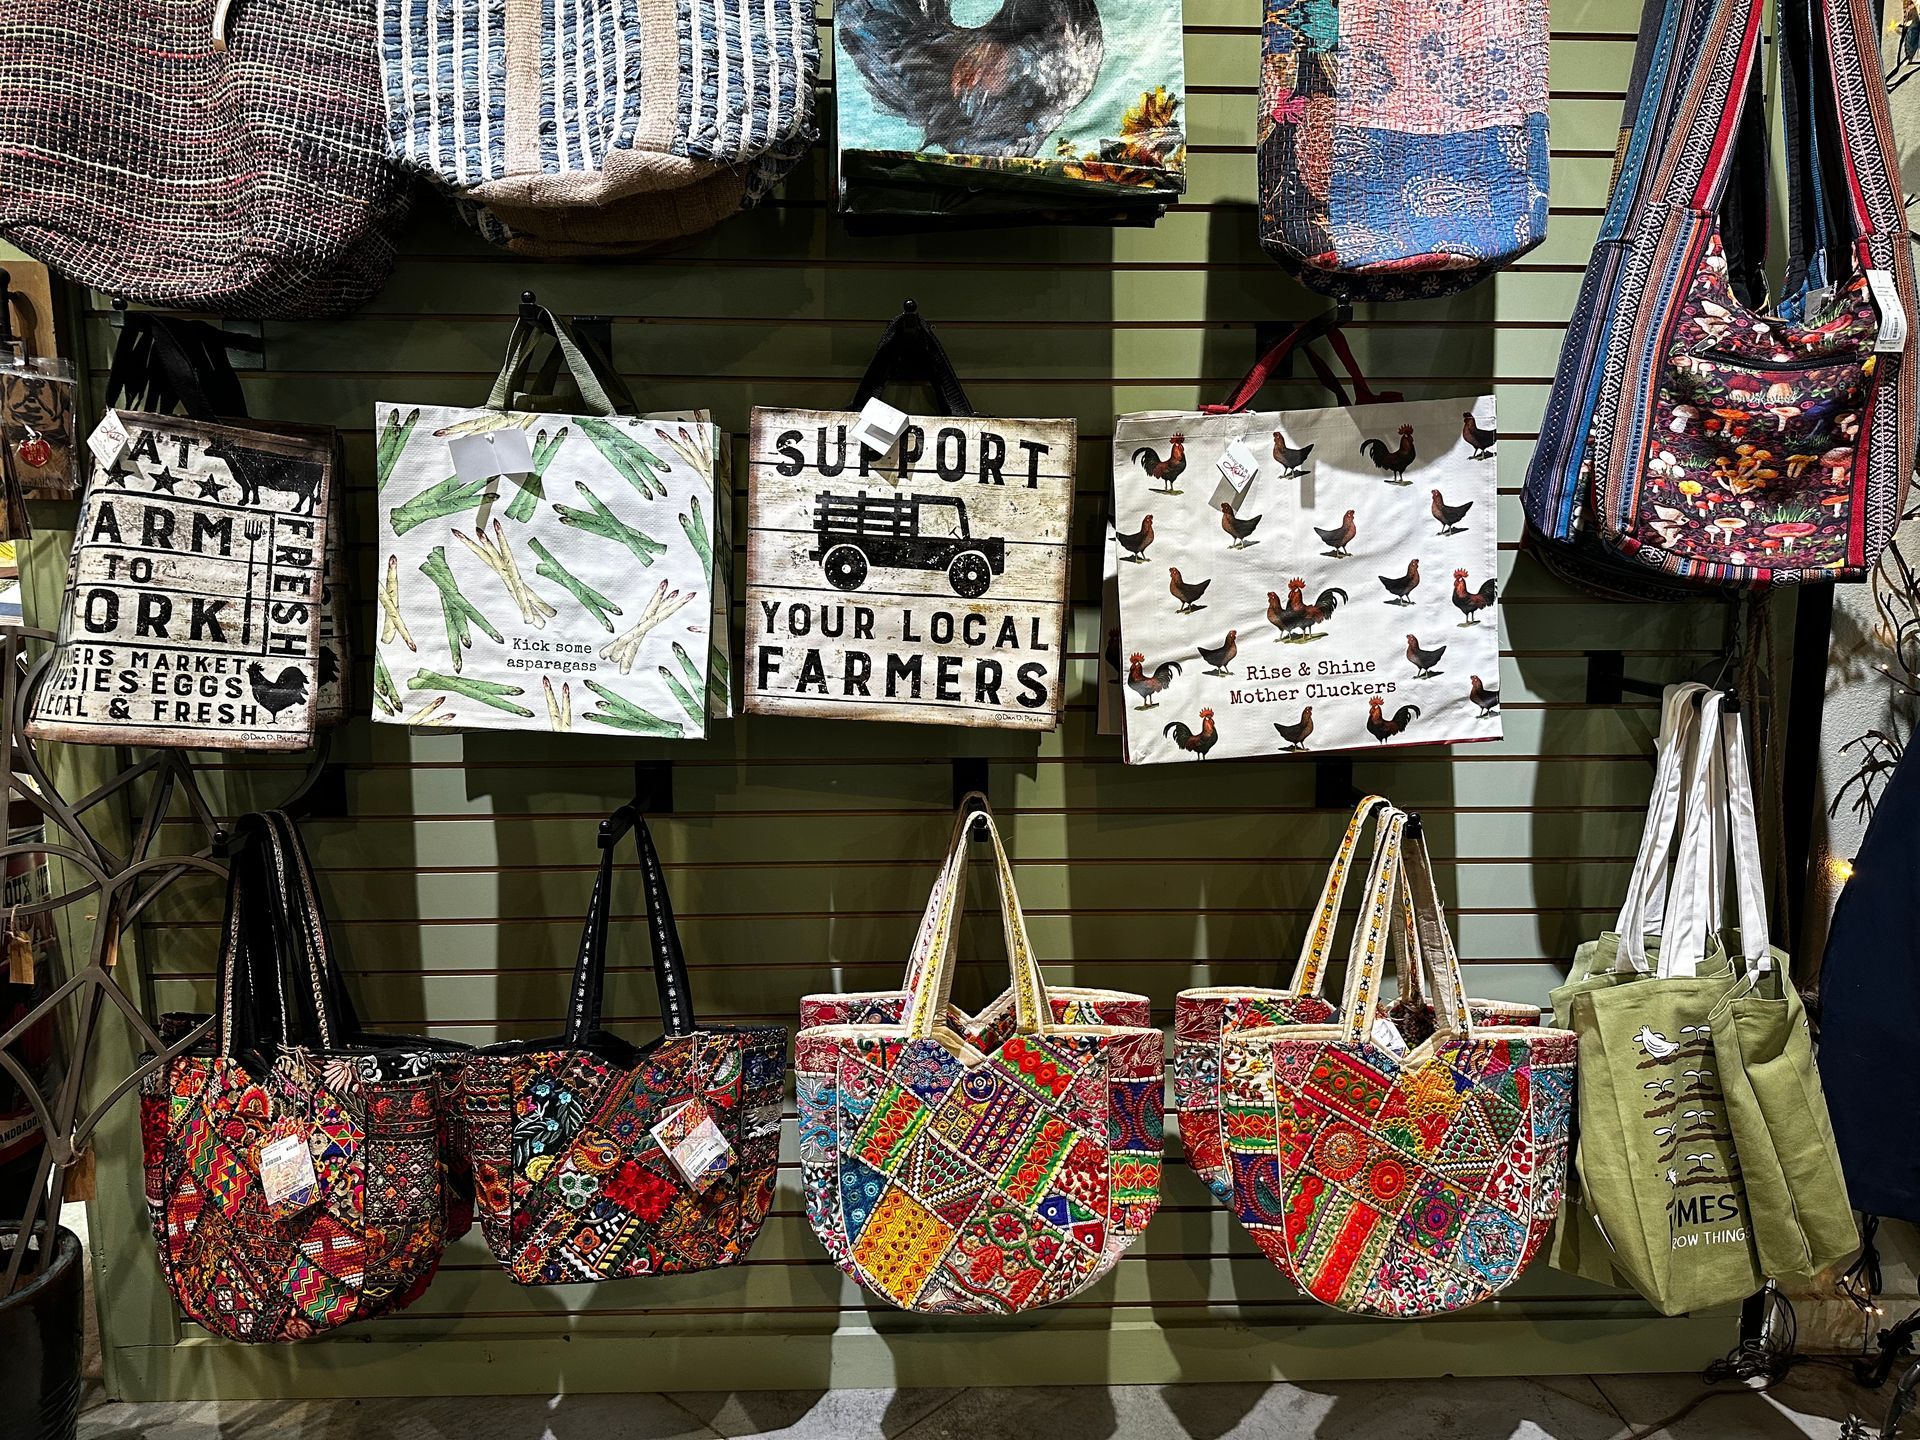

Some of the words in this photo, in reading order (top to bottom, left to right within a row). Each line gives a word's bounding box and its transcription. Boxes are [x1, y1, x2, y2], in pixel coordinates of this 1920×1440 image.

[127, 430, 200, 470] AT
[91, 501, 234, 557] ARM
[104, 554, 154, 584] TO
[269, 517, 315, 657] FRESH
[84, 589, 229, 644] ORK
[761, 600, 875, 640] YOUR
[902, 610, 1050, 651] LOCAL
[513, 638, 550, 652] Kick
[556, 643, 593, 654] some
[131, 652, 248, 676] MARKET
[506, 658, 598, 673] asparagass
[757, 645, 1049, 709] FARMERS
[1246, 665, 1292, 681] Rise
[1298, 662, 1311, 676] &
[1318, 659, 1376, 675] Shine
[151, 673, 243, 698] EGGS
[1230, 688, 1300, 705] Mother
[1306, 681, 1397, 698] Cluckers
[109, 697, 132, 719] &
[153, 700, 258, 725] FRESH
[1676, 1194, 1739, 1228] MES
[1672, 1233, 1699, 1250] ROW
